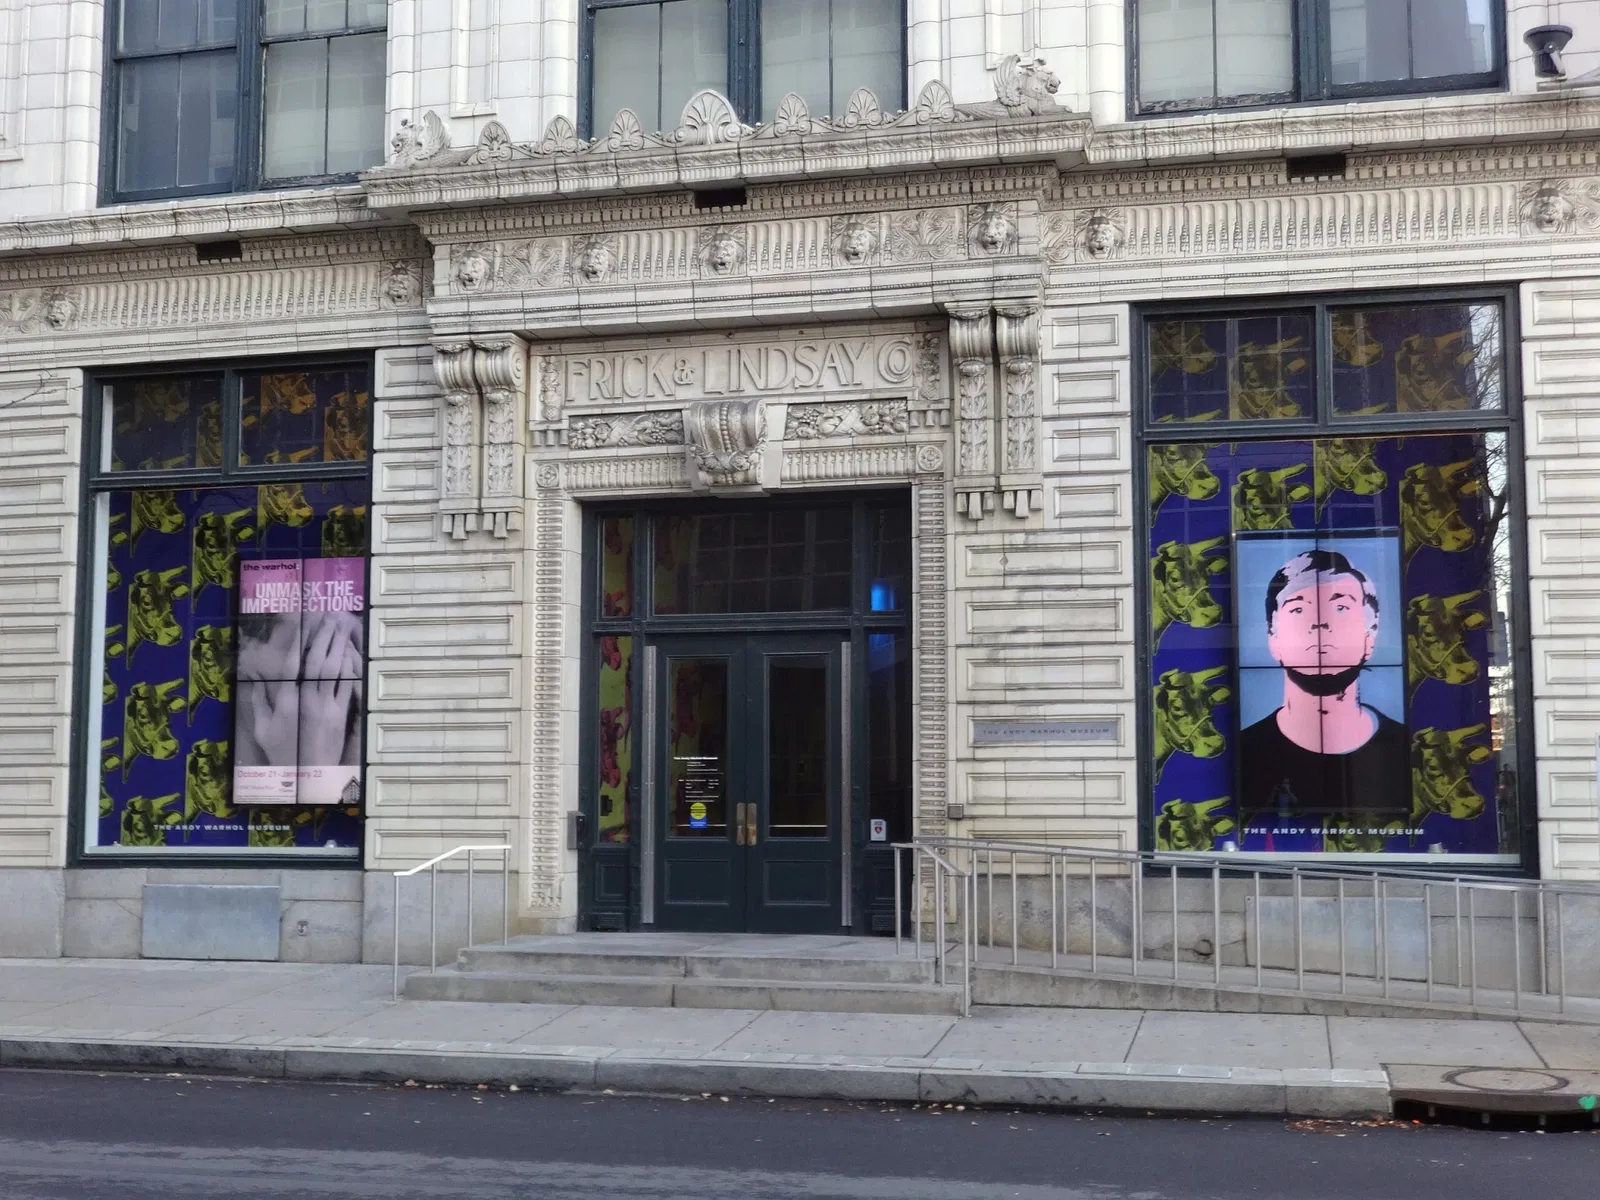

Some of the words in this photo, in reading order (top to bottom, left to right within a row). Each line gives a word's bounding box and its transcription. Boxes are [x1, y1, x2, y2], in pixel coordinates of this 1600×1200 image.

[565, 351, 674, 401] FRICK
[673, 357, 696, 386] &
[703, 340, 871, 394] LINDSAY
[243, 563, 260, 571] the
[256, 582, 322, 598] UNMASK
[325, 580, 355, 596] THE
[241, 595, 364, 613] IMPERFECTIONS
[238, 770, 266, 778] October
[313, 770, 323, 778] 22
